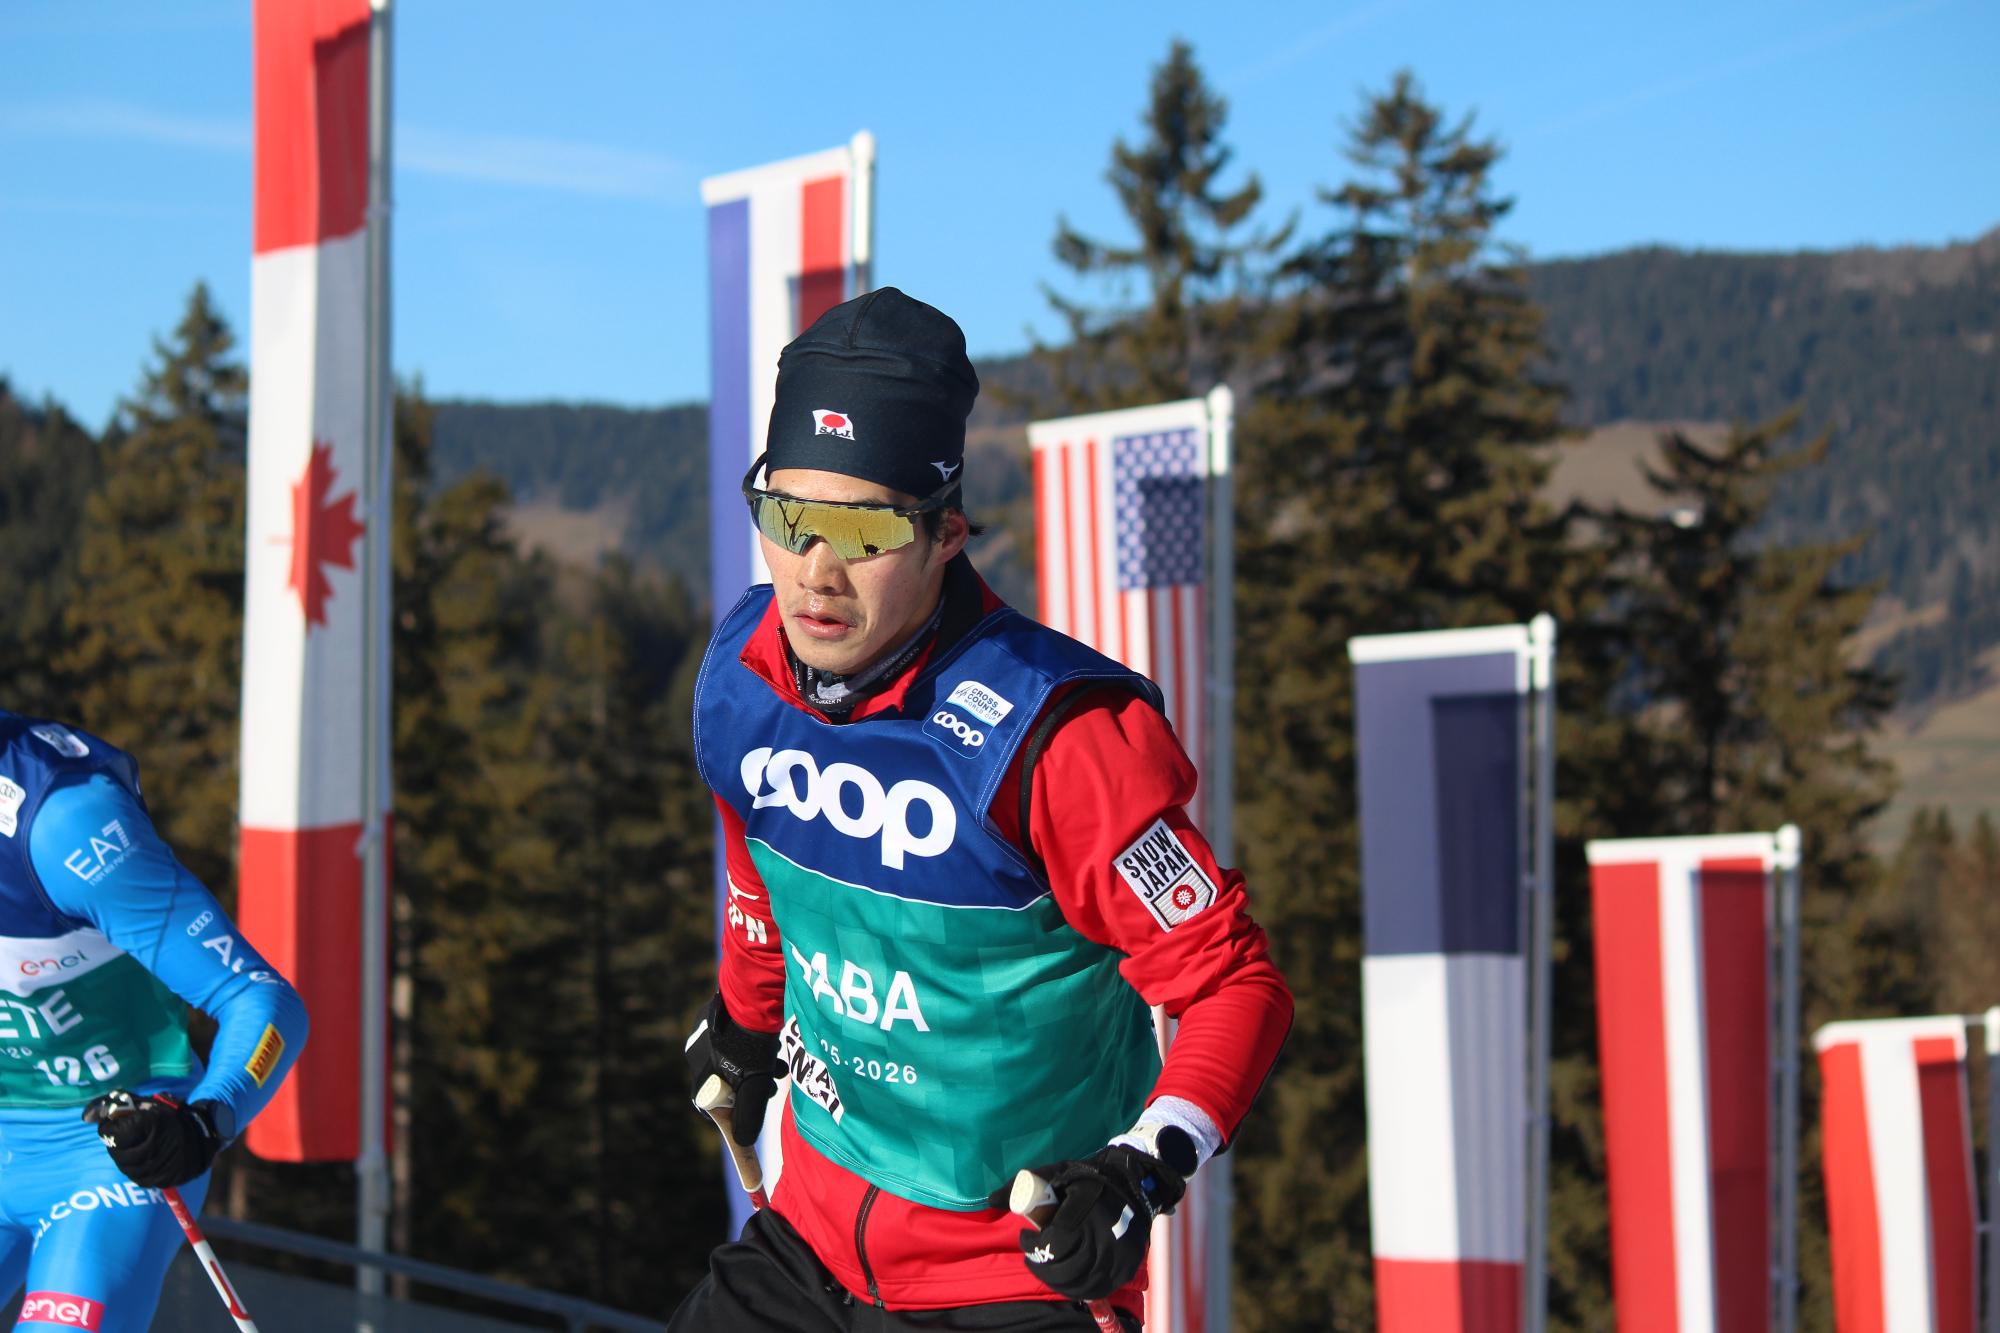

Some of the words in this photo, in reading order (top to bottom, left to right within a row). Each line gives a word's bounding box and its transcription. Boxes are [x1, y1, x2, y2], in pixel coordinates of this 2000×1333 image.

[967, 693, 1003, 719] COUNTRY
[971, 688, 999, 708] CROSS
[932, 711, 985, 747] coop
[740, 747, 957, 870] coop
[64, 819, 130, 881] EA7
[1122, 825, 1172, 879] SNOW
[1139, 844, 1190, 899] JAPAN
[20, 949, 89, 977] enel
[33, 1044, 120, 1087] 126
[21, 1299, 91, 1326] enel
